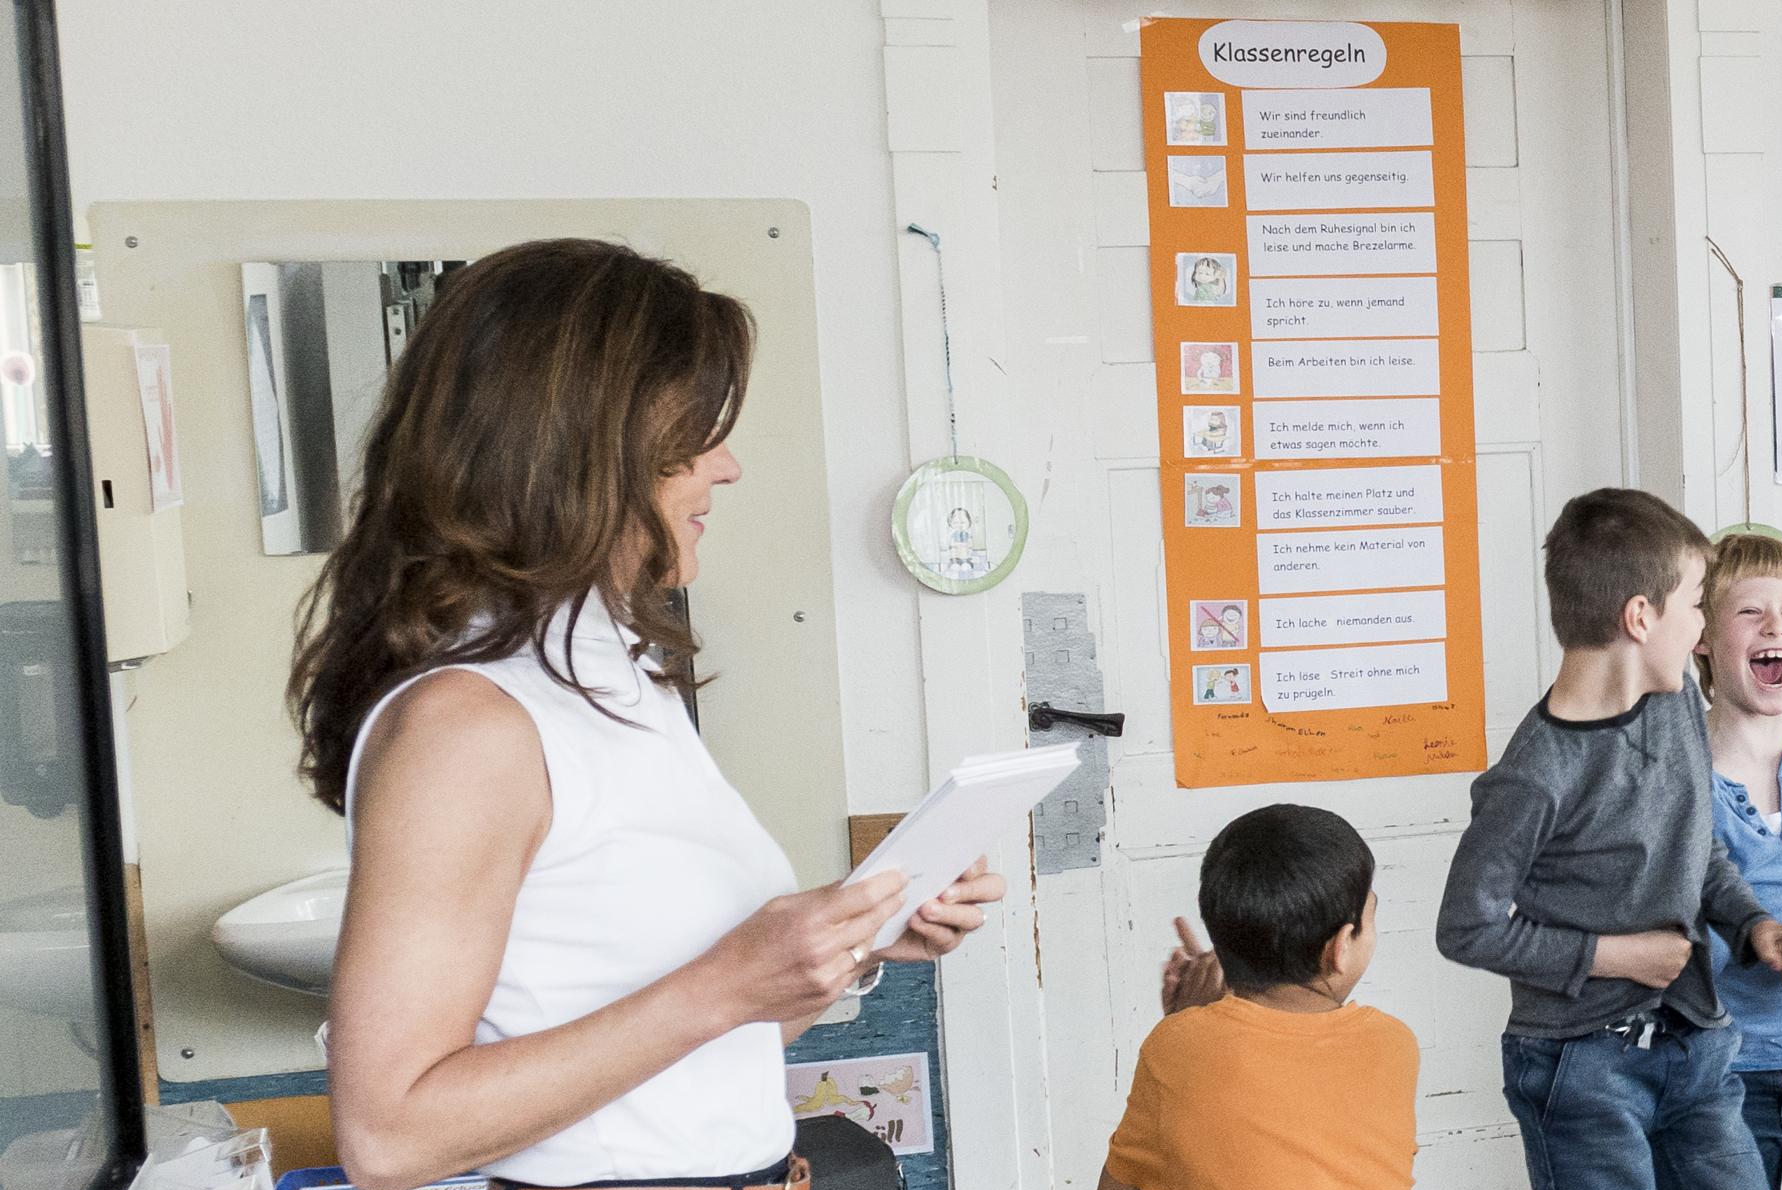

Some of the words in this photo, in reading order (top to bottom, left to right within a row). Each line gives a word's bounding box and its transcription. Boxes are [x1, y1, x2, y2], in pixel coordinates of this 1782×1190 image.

[1214, 42, 1365, 68] Klassenregeln
[1260, 112, 1280, 120] Wir
[1285, 111, 1306, 121] sind
[1310, 110, 1365, 120] freundlich
[1261, 129, 1324, 138] zueinander.
[1261, 173, 1281, 182] Wir
[1285, 172, 1320, 182] helfen
[1324, 174, 1342, 182] uns
[1345, 173, 1410, 184] gegenseitig.
[1262, 225, 1291, 234] Nach
[1295, 225, 1317, 234] dem
[1321, 223, 1376, 236] Ruhesignal
[1400, 223, 1415, 232] ich
[1264, 243, 1288, 252] leise
[1292, 242, 1311, 251] und
[1315, 242, 1349, 251] mache
[1353, 240, 1417, 250] Brezelarme.
[1266, 298, 1285, 308] Ich
[1366, 297, 1404, 309] jemand
[1267, 316, 1310, 327] spricht.
[1268, 357, 1294, 367] Beim
[1298, 358, 1346, 366] Arbeiten
[1350, 357, 1366, 366] bin
[1370, 356, 1385, 365] ich
[1389, 356, 1416, 365] leise.
[1270, 422, 1289, 432] Ich
[1293, 422, 1324, 431] melde
[1389, 420, 1404, 430] ich
[1270, 441, 1302, 449] etwas
[1306, 441, 1336, 451] sagen
[1272, 492, 1291, 502] Ich
[1295, 492, 1322, 501] halte
[1366, 489, 1392, 498] Platz
[1396, 488, 1414, 497] und
[1273, 510, 1291, 519] das
[1295, 509, 1374, 518] Klassenzimmer
[1378, 507, 1417, 515] sauber.
[1273, 544, 1292, 554] Ich
[1296, 544, 1330, 553] nehme
[1334, 543, 1356, 551] kein
[1360, 541, 1403, 550] Material
[1274, 563, 1321, 571] anderen.
[1276, 619, 1295, 628] Ich
[1299, 618, 1326, 628] lache
[1337, 615, 1392, 625] niemanden
[1277, 672, 1295, 682] Ich
[1299, 673, 1320, 681] löse
[1331, 670, 1363, 679] Streit
[1367, 669, 1392, 677] ohne
[1396, 666, 1420, 675] mich
[1293, 688, 1336, 700] prügeln.
